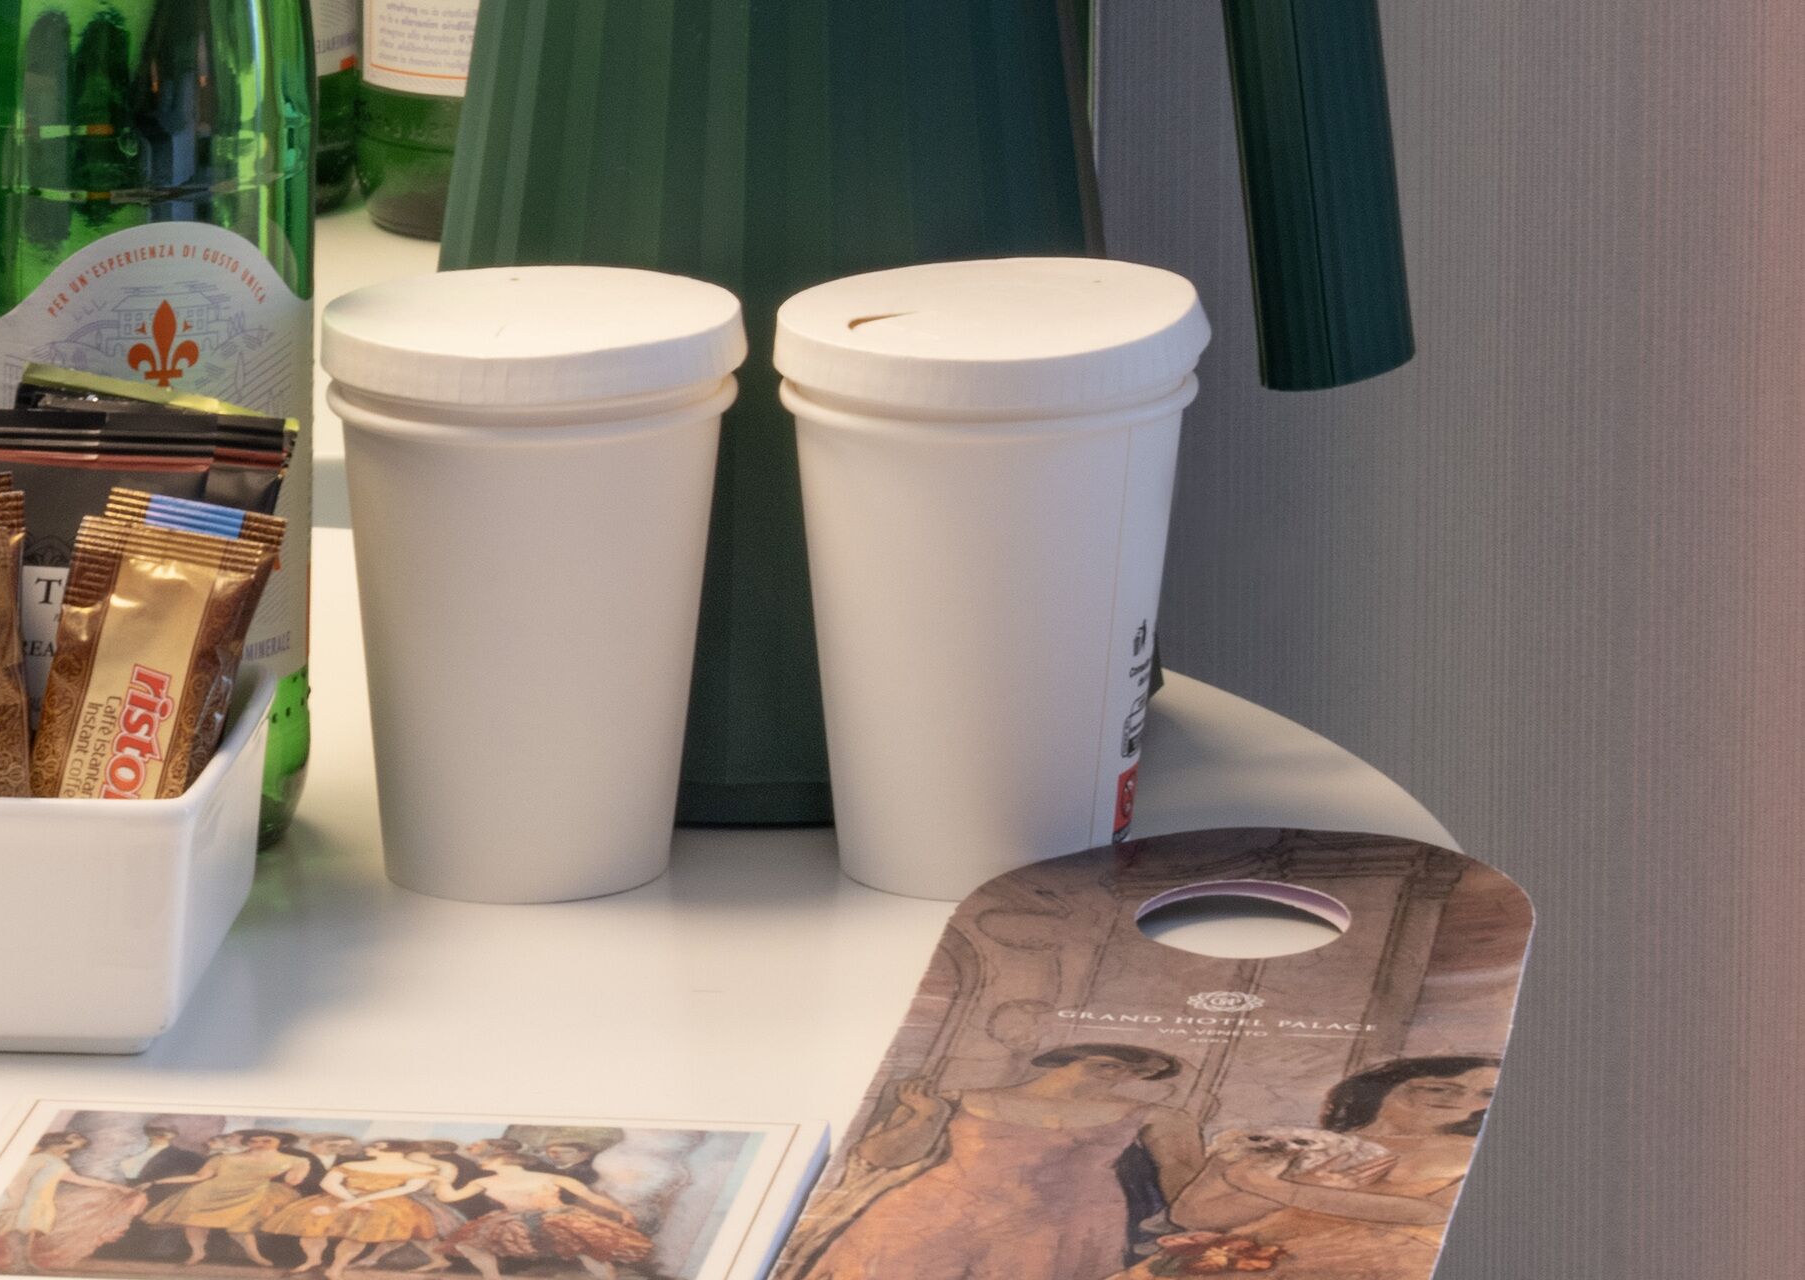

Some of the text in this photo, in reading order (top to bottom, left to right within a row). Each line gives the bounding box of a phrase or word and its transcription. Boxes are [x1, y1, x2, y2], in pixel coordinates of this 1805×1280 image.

[47, 292, 70, 318] PER
[68, 244, 175, 294] UN'ESPERIENZA
[182, 244, 197, 259] DI
[201, 248, 240, 274] GUSTO
[244, 630, 291, 662] MINERALE
[74, 701, 104, 756] Instant
[97, 695, 122, 736] Caffè
[1057, 1009, 1379, 1032] GRAND HOTEL PALACE
[1158, 1027, 1269, 1037] VIA VENETO
